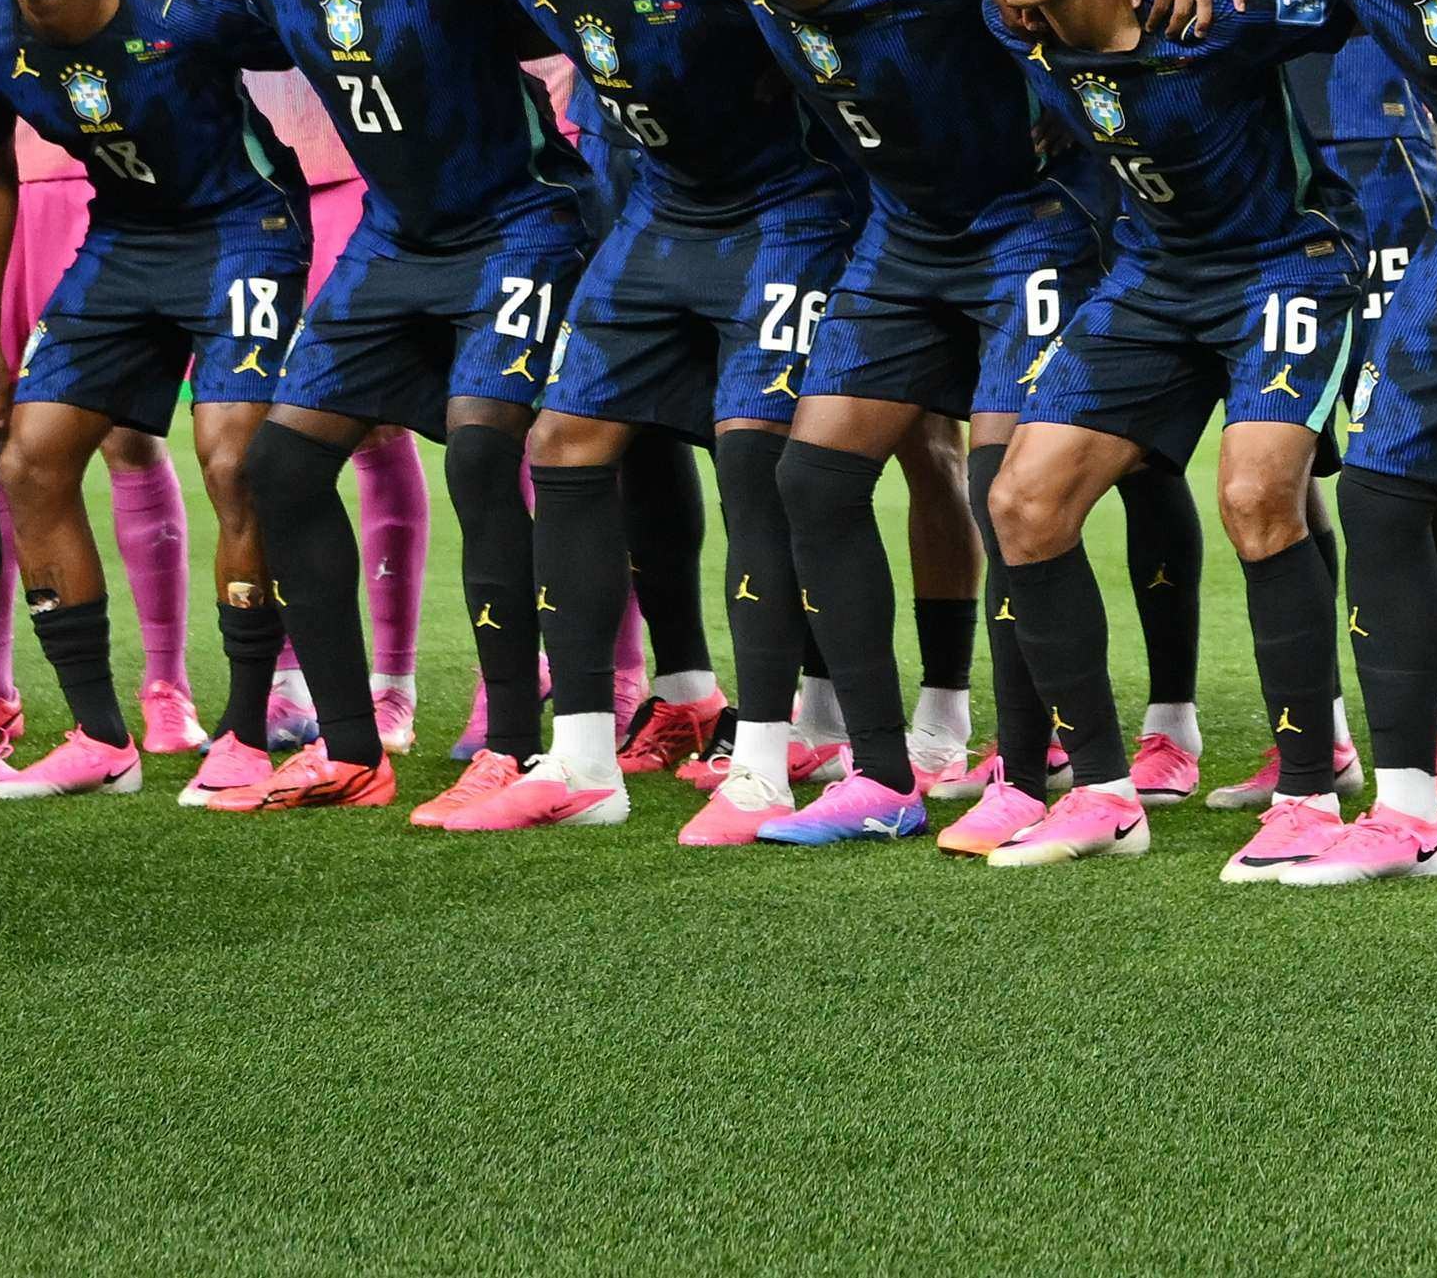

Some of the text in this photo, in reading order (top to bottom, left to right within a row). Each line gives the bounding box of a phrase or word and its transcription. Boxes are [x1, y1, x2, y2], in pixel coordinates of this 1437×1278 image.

[331, 49, 371, 62] BRASIL
[337, 75, 403, 134] 21
[593, 74, 633, 89] BRASIL
[79, 121, 123, 134] BRASIL
[836, 101, 882, 149] 6
[94, 141, 157, 185] 18
[1110, 155, 1176, 203] 16
[227, 277, 279, 340] 18
[494, 276, 553, 344] 21
[1025, 268, 1061, 336] 6
[1261, 293, 1319, 356] 16
